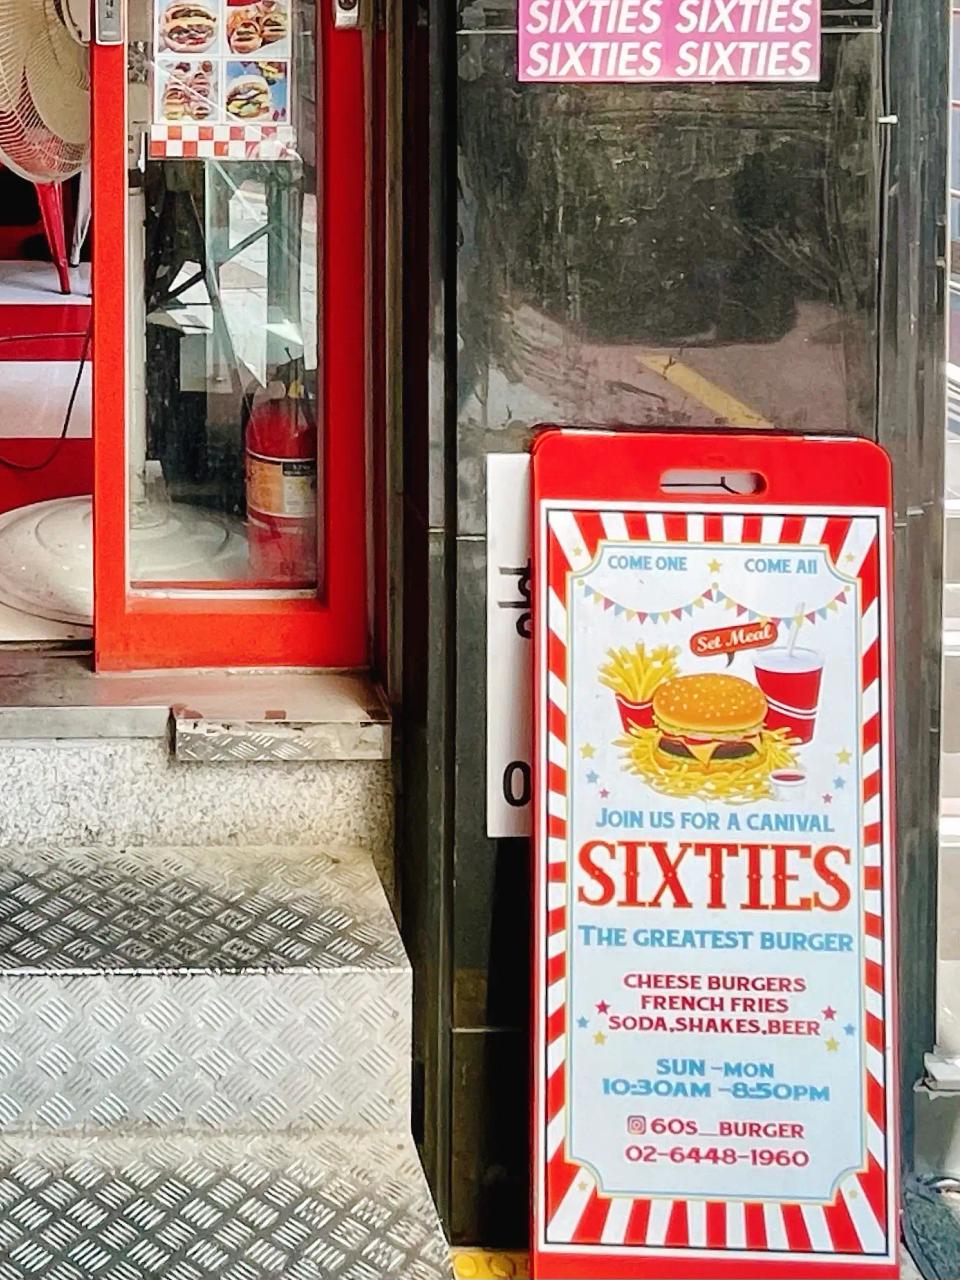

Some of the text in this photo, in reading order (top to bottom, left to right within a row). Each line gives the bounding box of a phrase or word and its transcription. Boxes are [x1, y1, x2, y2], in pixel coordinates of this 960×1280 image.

[526, 0, 662, 34] SIXTIES
[526, 41, 812, 77] SIXTIES SIXTIES
[608, 556, 687, 571] COME ONE
[744, 559, 791, 573] COME
[697, 626, 772, 652] Set Meal
[650, 812, 674, 828] US
[681, 812, 720, 830] FOR
[727, 813, 741, 830] A
[747, 814, 835, 832] CANIVAL
[579, 841, 850, 911] SIXTIES
[633, 929, 753, 949] GREATEST
[760, 932, 853, 951] BURGER
[624, 974, 806, 992] CHEESE BURGERS
[642, 995, 788, 1013] FRENCH FRIES
[657, 1059, 705, 1076] SUN
[626, 1146, 809, 1166] 02-6448-1960
